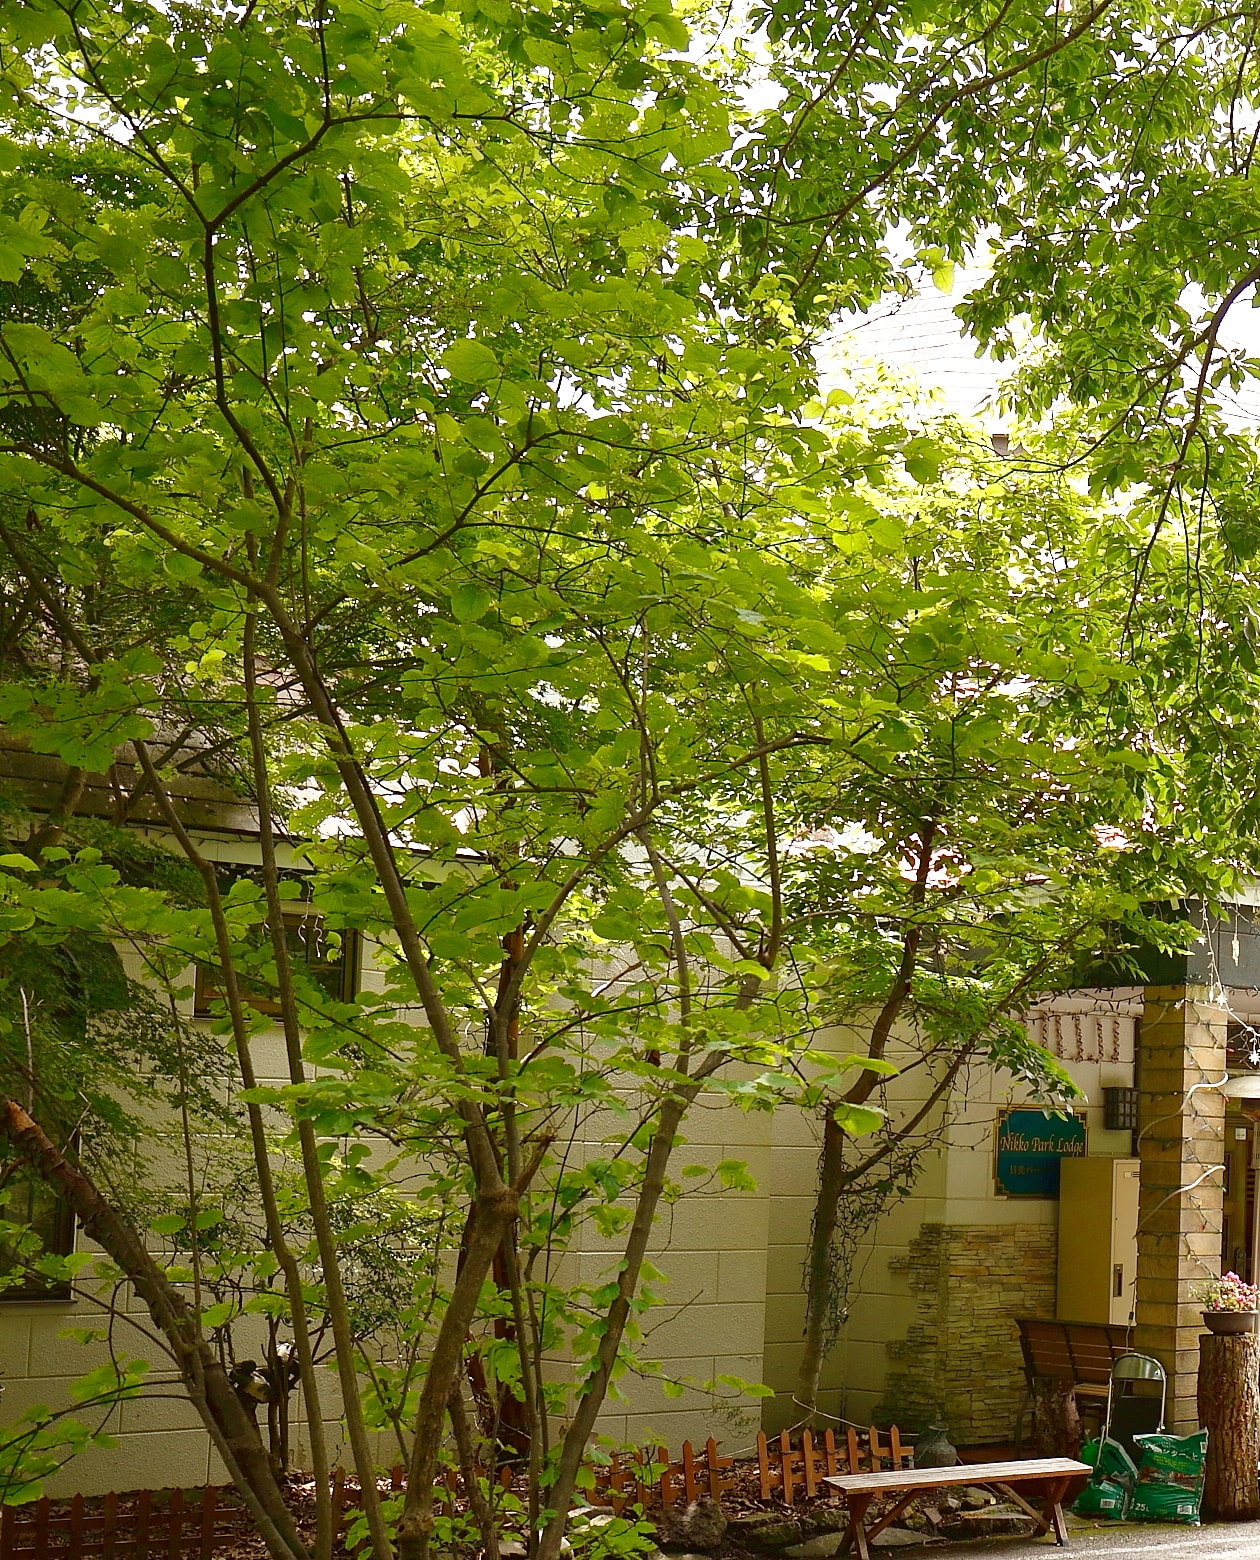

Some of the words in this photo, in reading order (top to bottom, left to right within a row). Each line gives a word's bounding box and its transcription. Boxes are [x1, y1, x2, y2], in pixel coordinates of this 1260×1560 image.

[1000, 1132, 1030, 1152] Nikko
[1031, 1134, 1055, 1152] Park
[1056, 1135, 1084, 1157] Lodge
